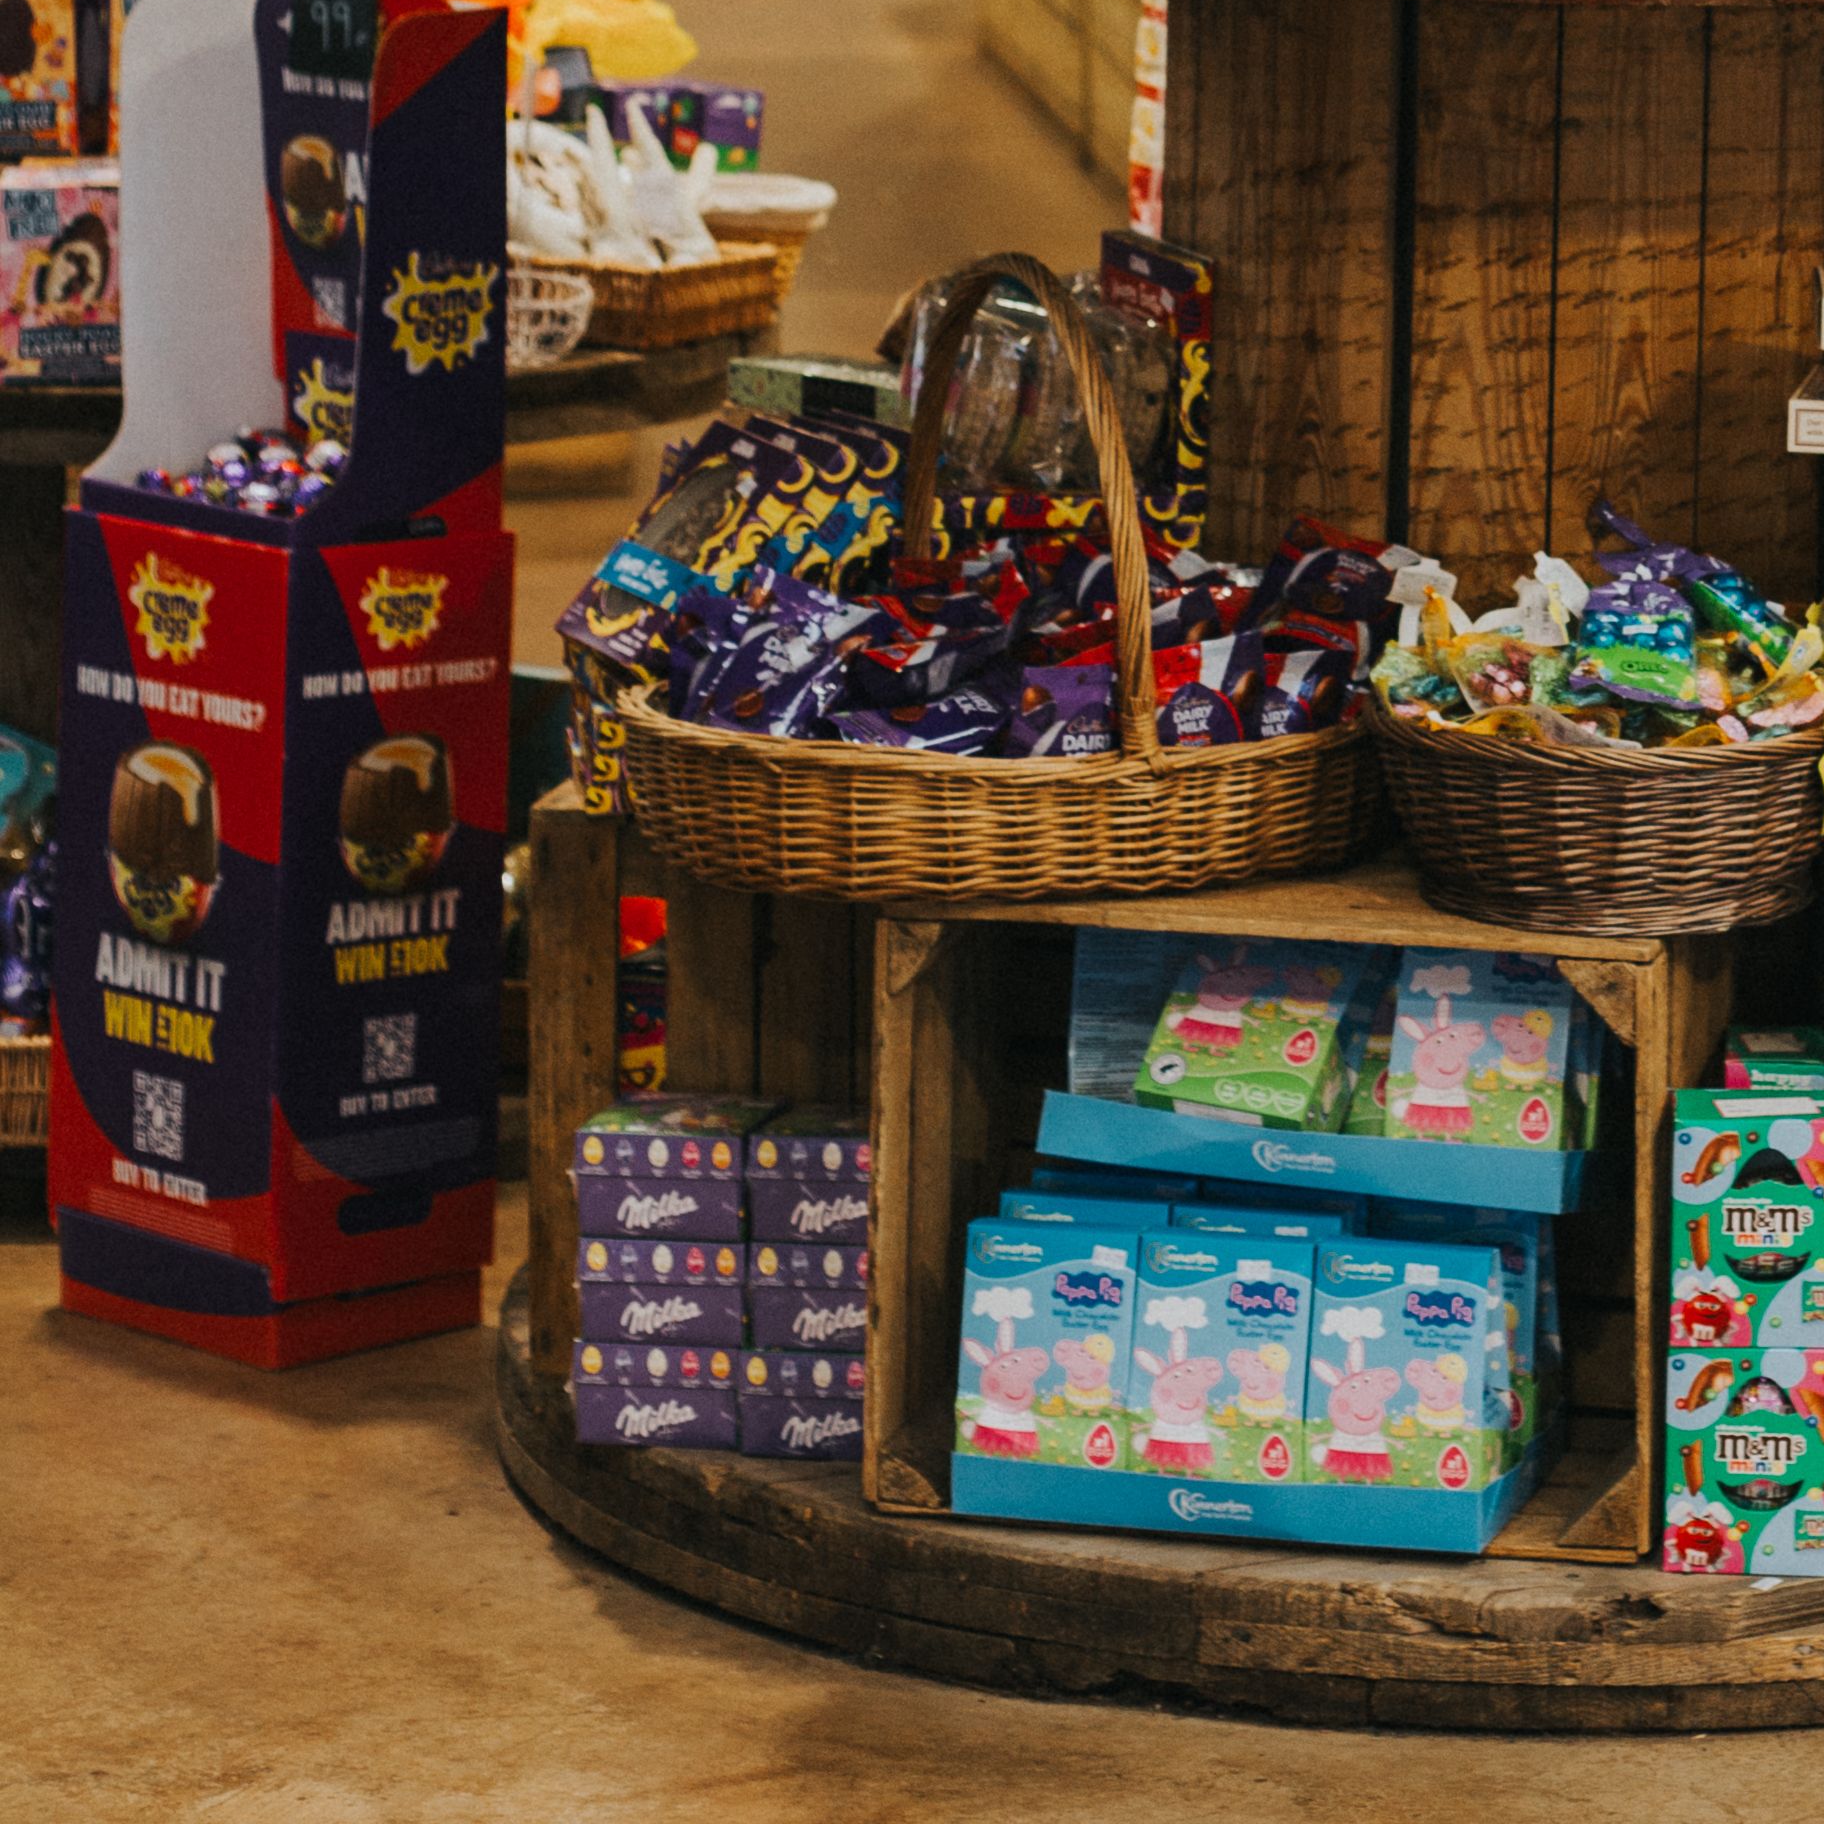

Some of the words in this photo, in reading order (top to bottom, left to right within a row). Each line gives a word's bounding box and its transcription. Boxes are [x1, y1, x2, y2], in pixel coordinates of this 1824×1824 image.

[77, 663, 110, 699] HOW
[111, 670, 136, 704] DO
[137, 676, 165, 713] YOU
[168, 682, 200, 720] EAT
[201, 690, 267, 733] YOURS?
[302, 673, 339, 700] HOW
[341, 670, 364, 696] DO
[366, 666, 400, 694] YOU
[401, 662, 433, 691] EAT
[1172, 706, 1213, 723] DAIRY
[1177, 719, 1210, 736] MILK
[1260, 708, 1291, 726] AIRY
[325, 893, 425, 946] ADMIT
[430, 887, 462, 931] IT
[95, 931, 190, 1004] ADMIT
[195, 958, 226, 1013] IT
[334, 942, 387, 987] WIN
[103, 988, 153, 1048] WIN
[339, 1092, 367, 1118] BUY
[392, 1083, 438, 1111] ENTER
[112, 1157, 140, 1188] BUY
[142, 1165, 160, 1194] TO
[162, 1170, 208, 1208] ENTER
[617, 1189, 699, 1231] Milka
[790, 1194, 868, 1234] Milka
[1056, 1273, 1098, 1302] Peppa
[1099, 1275, 1122, 1306] Pig
[1230, 1282, 1273, 1312] Peppa
[1274, 1285, 1297, 1315] Pig
[1406, 1292, 1449, 1322] Peppa
[1451, 1296, 1475, 1325] Pig
[620, 1295, 703, 1336] Milka
[792, 1303, 868, 1342] Milka
[615, 1399, 699, 1438] Milka
[781, 1412, 863, 1449] Milka
